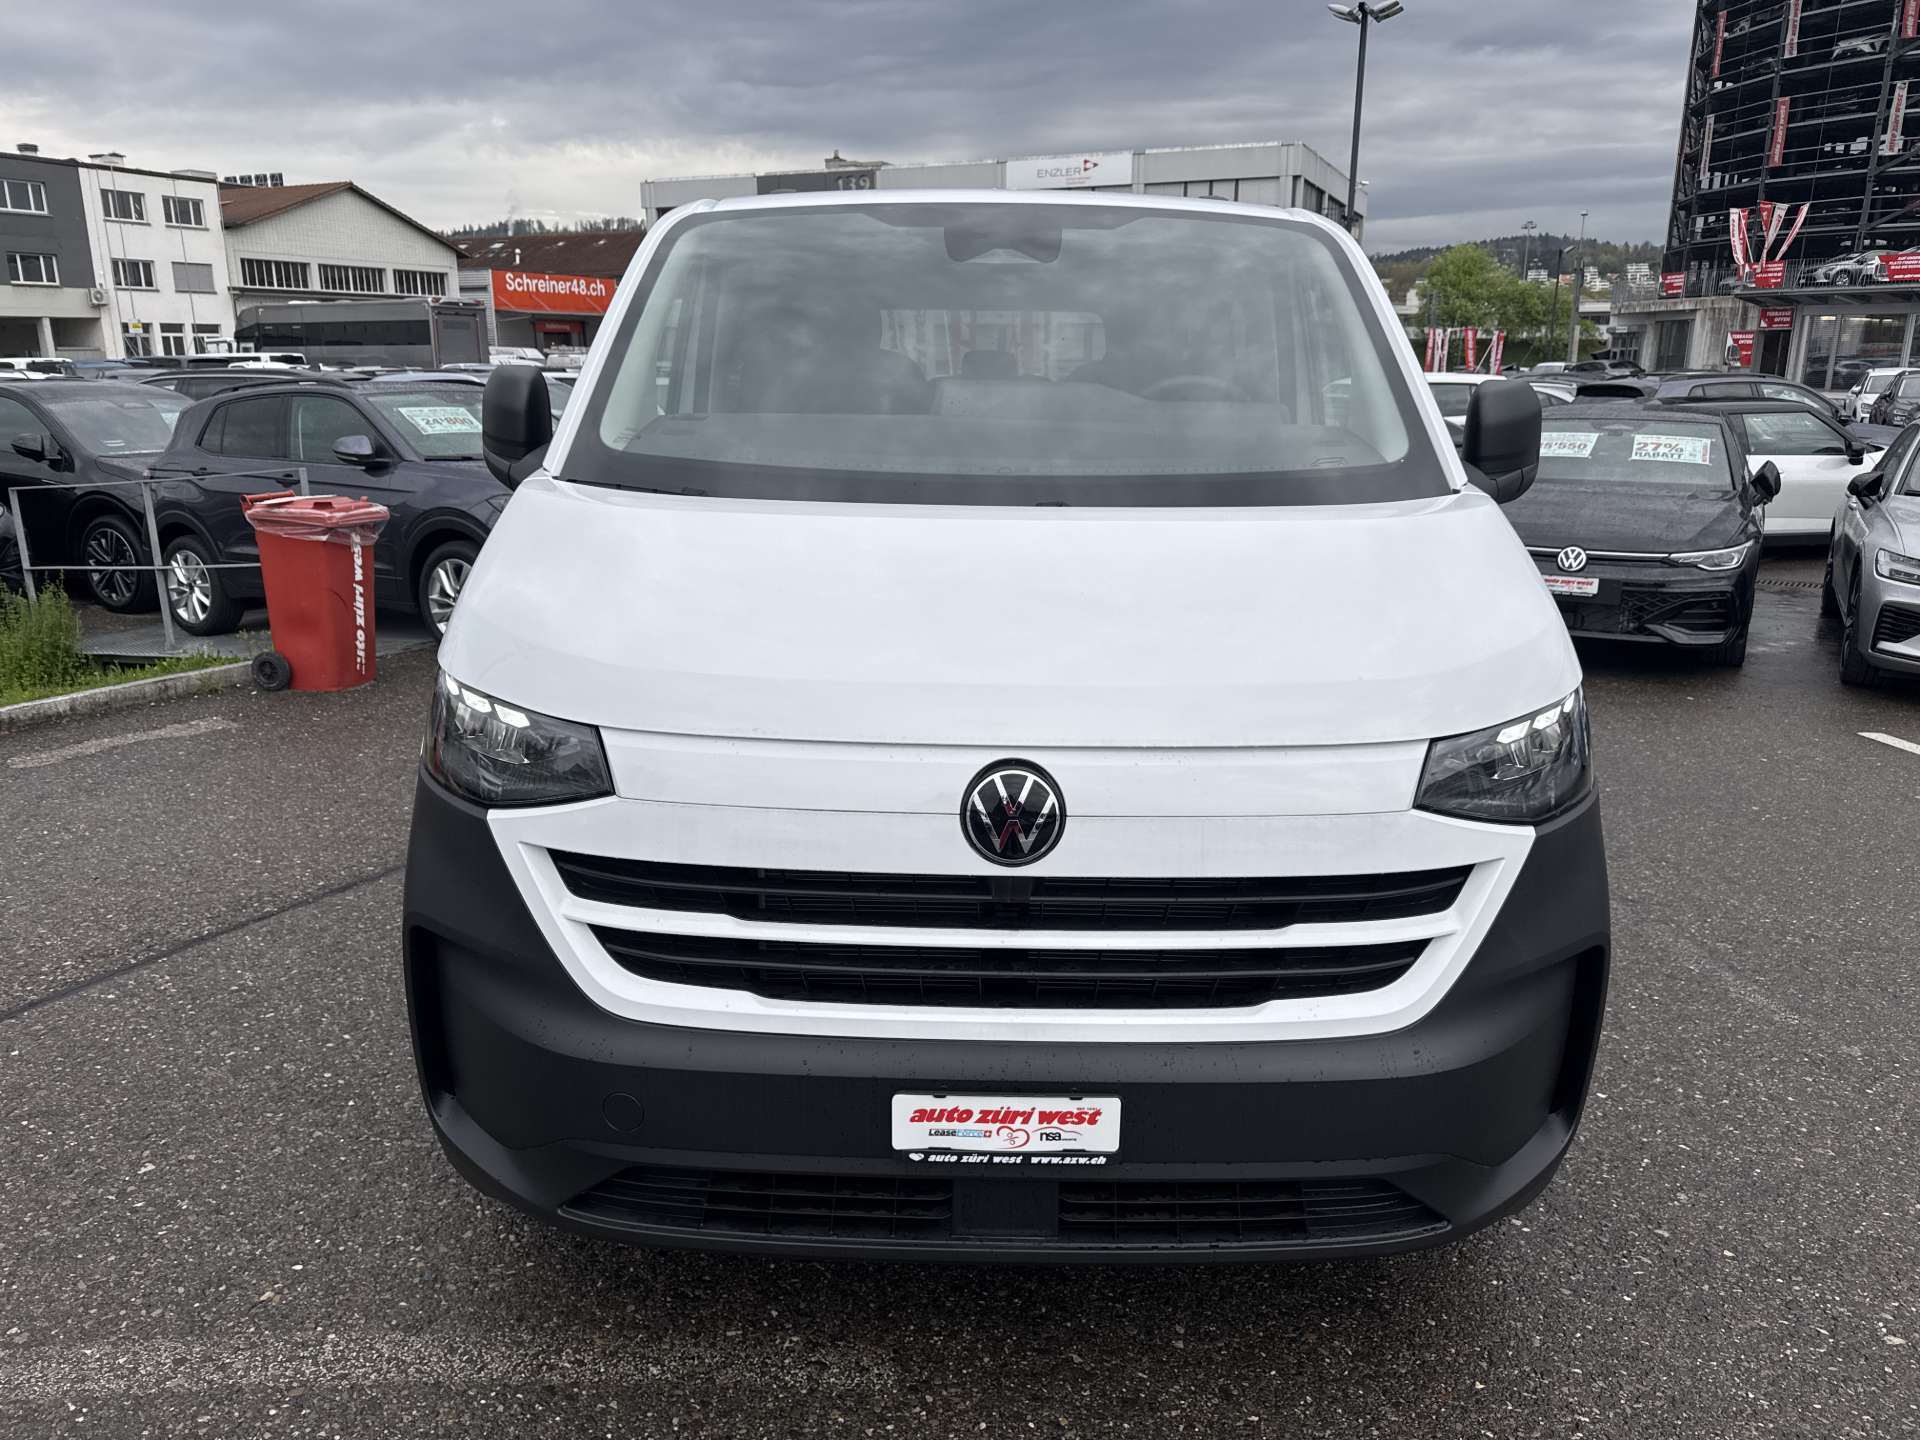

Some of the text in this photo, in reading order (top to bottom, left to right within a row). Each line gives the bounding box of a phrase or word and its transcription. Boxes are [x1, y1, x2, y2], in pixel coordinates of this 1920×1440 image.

[1037, 167, 1081, 178] ENZLER
[505, 272, 606, 297] Schreiner48.ch
[1636, 442, 1684, 453] 27%
[1635, 452, 1684, 460] RABATT
[353, 583, 366, 629] züri
[910, 1106, 1103, 1126] auto züri west
[1040, 1131, 1061, 1142] nsa
[928, 1153, 958, 1162] auto
[960, 1153, 990, 1163] züri
[993, 1154, 1023, 1164] west
